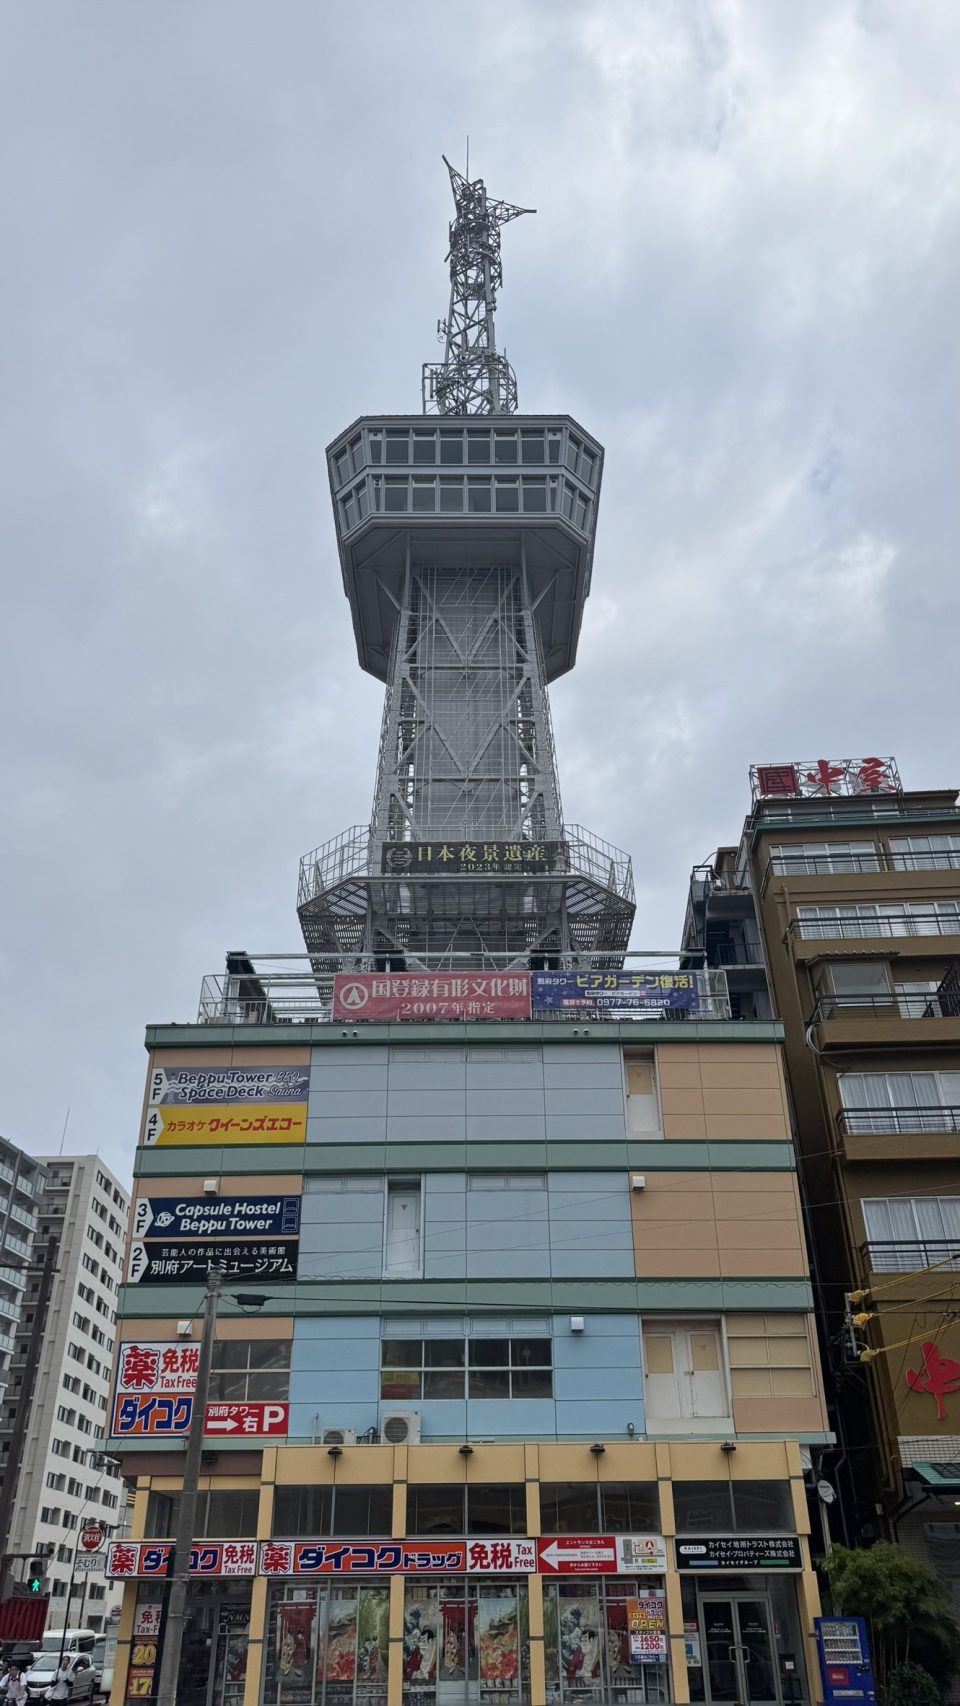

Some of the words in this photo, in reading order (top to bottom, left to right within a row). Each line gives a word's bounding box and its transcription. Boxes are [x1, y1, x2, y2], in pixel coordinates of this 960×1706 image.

[417, 844, 548, 862] 日本夜景遺産
[371, 978, 528, 998] 国登録有形文化財
[537, 977, 575, 986] 別府タワー
[401, 1001, 497, 1015] 2007年指定
[178, 1071, 225, 1087] Beppu
[229, 1070, 273, 1083] Tower
[276, 1071, 300, 1083] BBQ
[179, 1086, 227, 1102] Space
[226, 1085, 265, 1097] Deck
[268, 1085, 301, 1097] Sauna
[167, 1120, 207, 1132] カラオケ
[208, 1115, 302, 1132] クイーンズエコー
[175, 1203, 232, 1219] Capsule
[234, 1201, 281, 1215] Hostel
[180, 1218, 226, 1234] Beppu
[229, 1217, 273, 1230] Tower
[161, 1246, 286, 1257] 芸能人の作品に出会える美術館
[150, 1257, 294, 1275] 別府アートミュージアム
[122, 1345, 159, 1388] 薬
[161, 1348, 199, 1374] 免税
[160, 1376, 176, 1388] Tax
[176, 1376, 197, 1388] Free
[119, 1396, 194, 1431] ダイコク
[208, 1406, 259, 1417] 別府タワー
[262, 1406, 285, 1432] P
[242, 1416, 258, 1432] 右
[223, 1544, 255, 1565] 免税
[263, 1543, 291, 1573] 薬
[468, 1542, 513, 1570] 免税
[516, 1543, 533, 1555] Tax
[110, 1544, 136, 1575] 薬
[514, 1557, 535, 1568] Free
[223, 1565, 237, 1574] Tax
[237, 1565, 252, 1574] Free
[137, 1624, 160, 1634] Tax-F
[631, 1619, 664, 1630] OPEN
